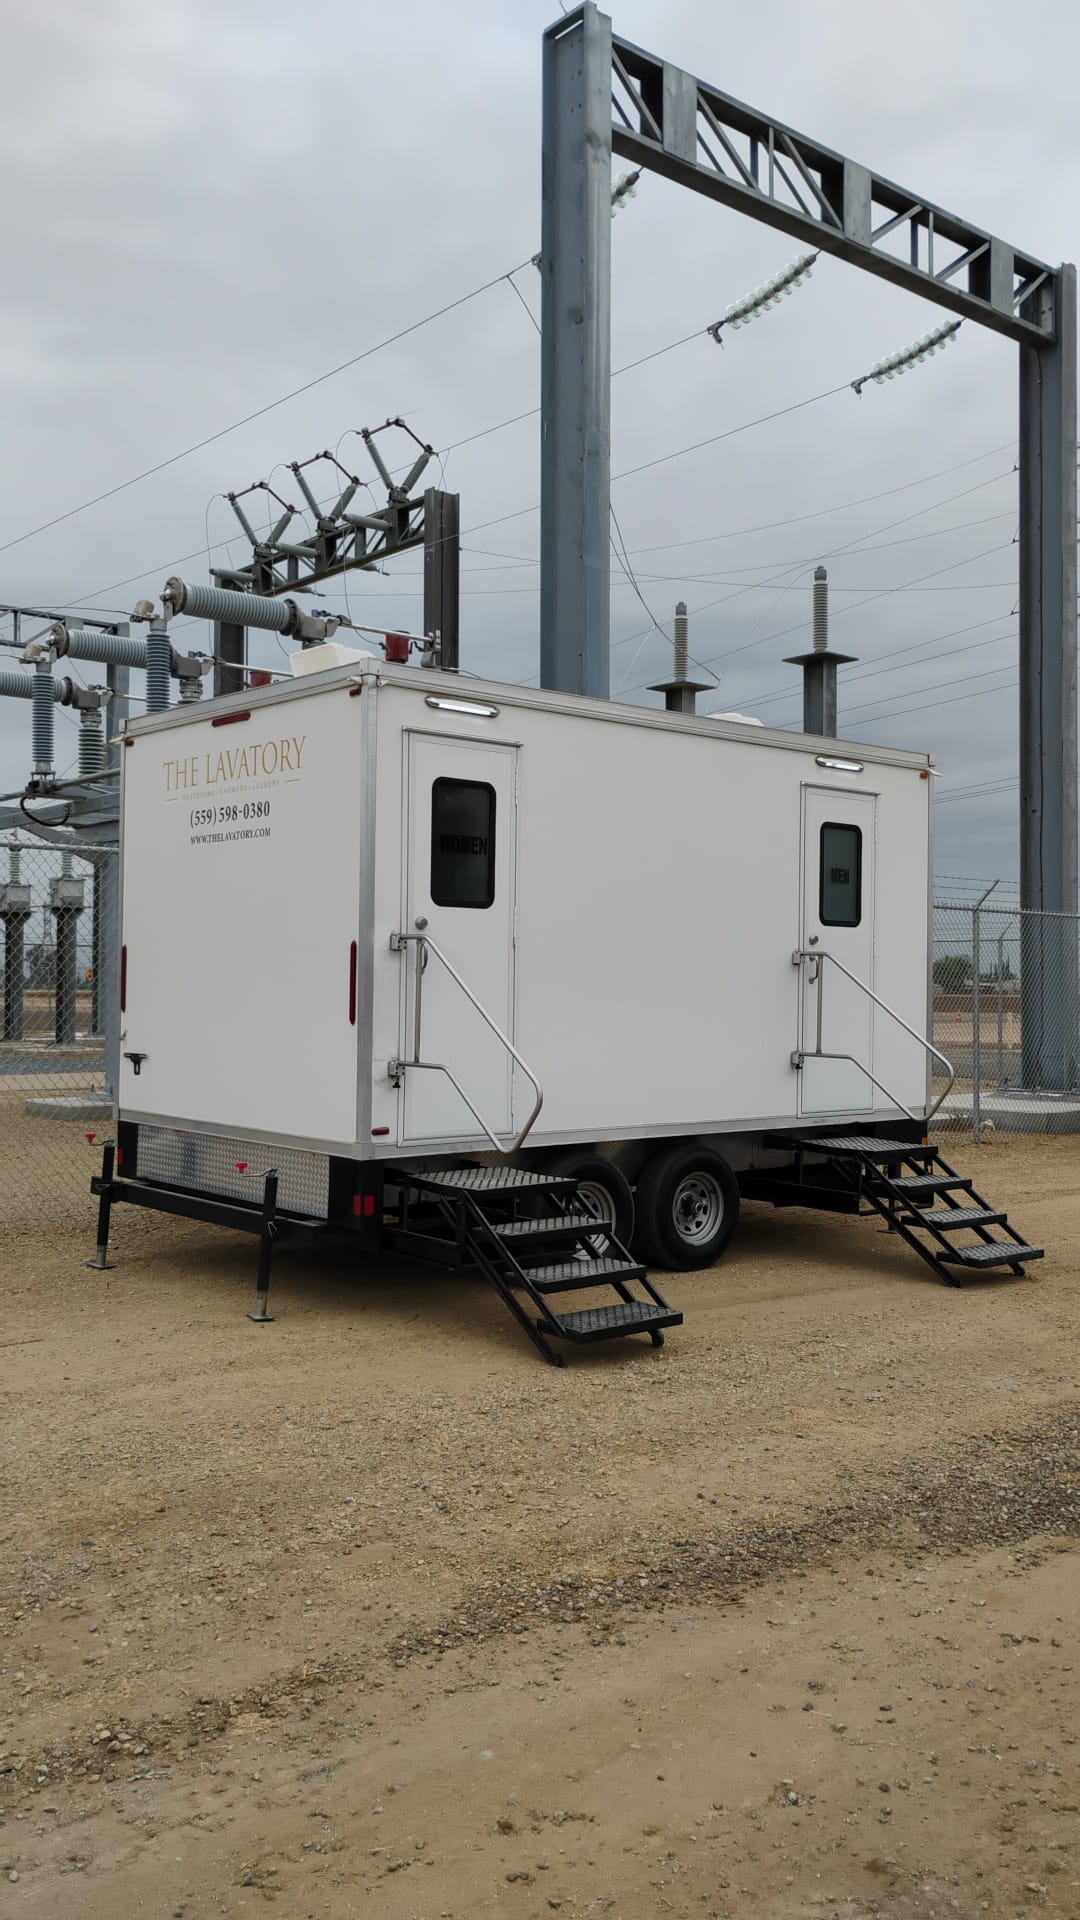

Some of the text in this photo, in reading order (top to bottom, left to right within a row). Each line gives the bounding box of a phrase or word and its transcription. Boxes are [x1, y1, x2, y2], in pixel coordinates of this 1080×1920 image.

[163, 736, 306, 791] THE LAVATORY
[219, 800, 271, 823] 598-0380
[190, 827, 271, 845] WWW.THELAVATORY.COM
[440, 833, 488, 856] WOMEN
[831, 867, 850, 885] MEN
